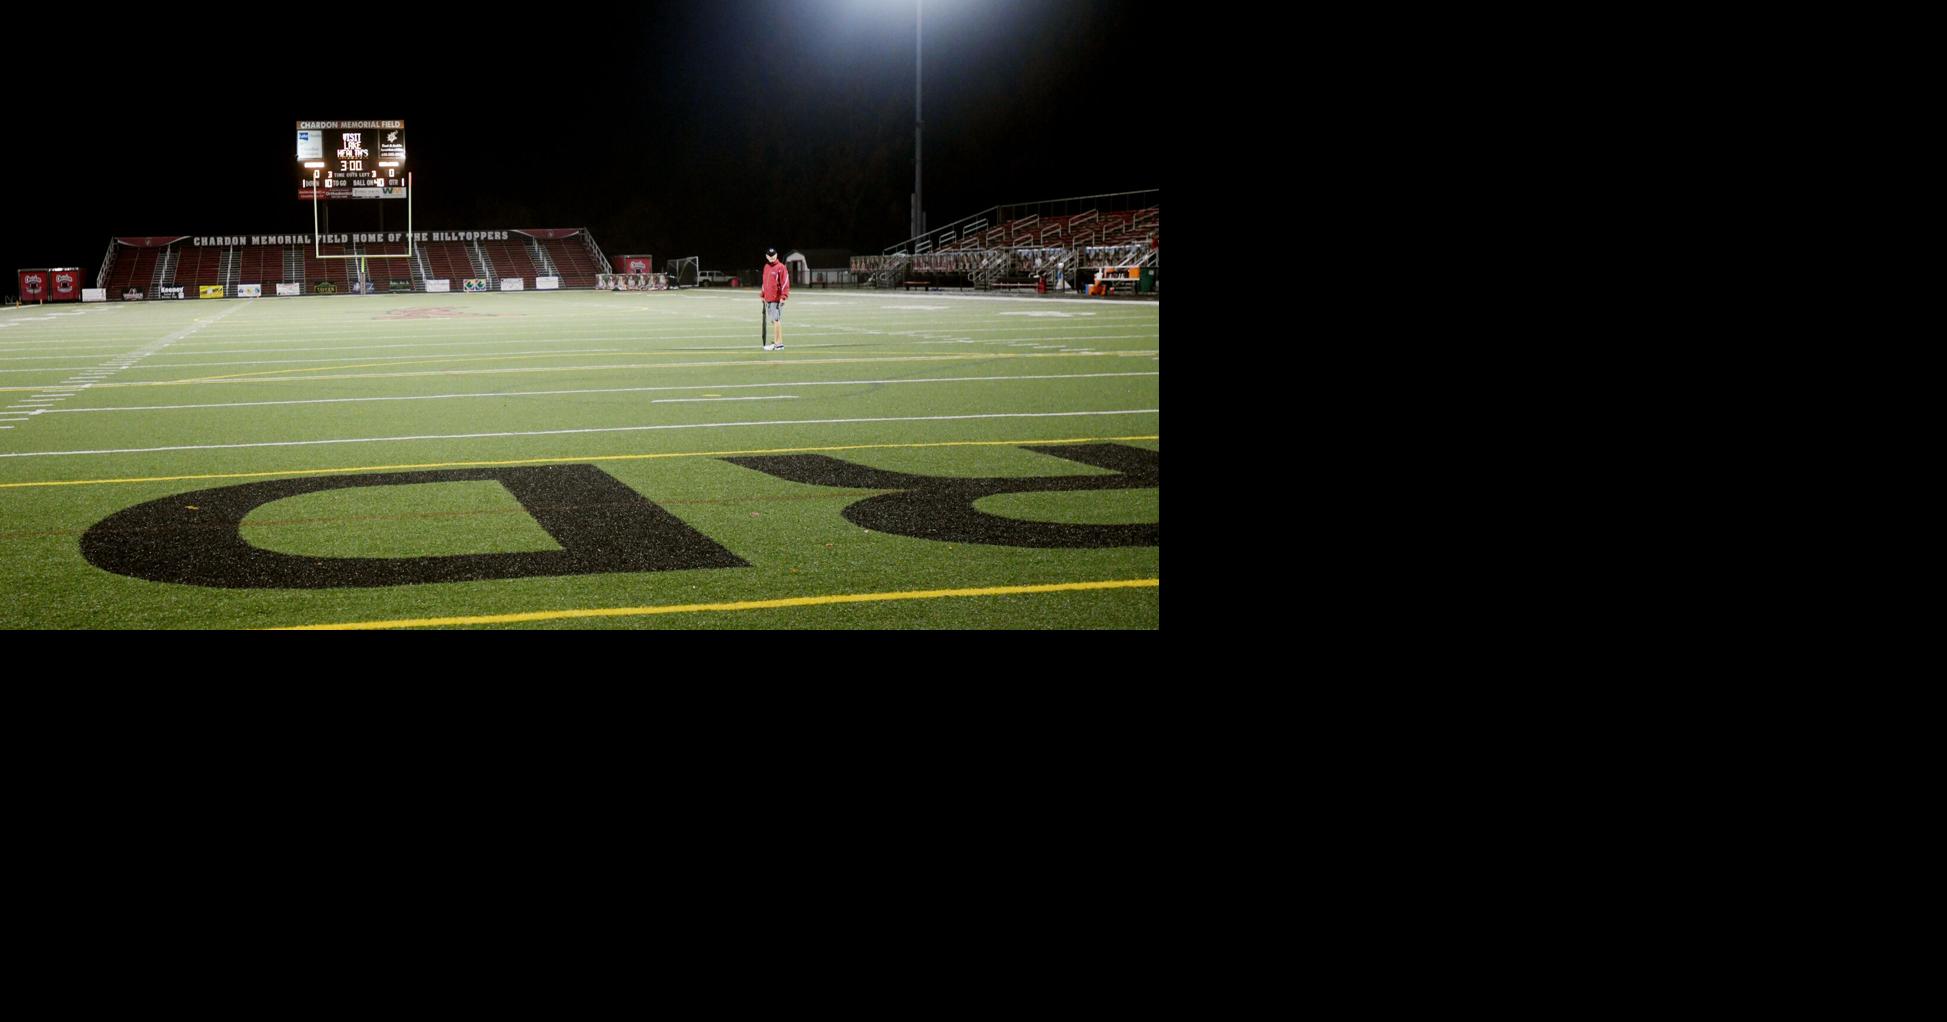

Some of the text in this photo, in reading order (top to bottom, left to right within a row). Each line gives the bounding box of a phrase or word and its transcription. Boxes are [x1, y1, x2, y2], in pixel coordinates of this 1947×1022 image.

[300, 121, 338, 129] CHARDON
[381, 120, 401, 128] FIELD
[343, 133, 361, 141] VISIT
[343, 141, 361, 149] LAKE
[388, 168, 394, 178] 0
[193, 231, 509, 246] CHARDON MEMORIAL FIELD HOME OF THE HILLTOPPERS
